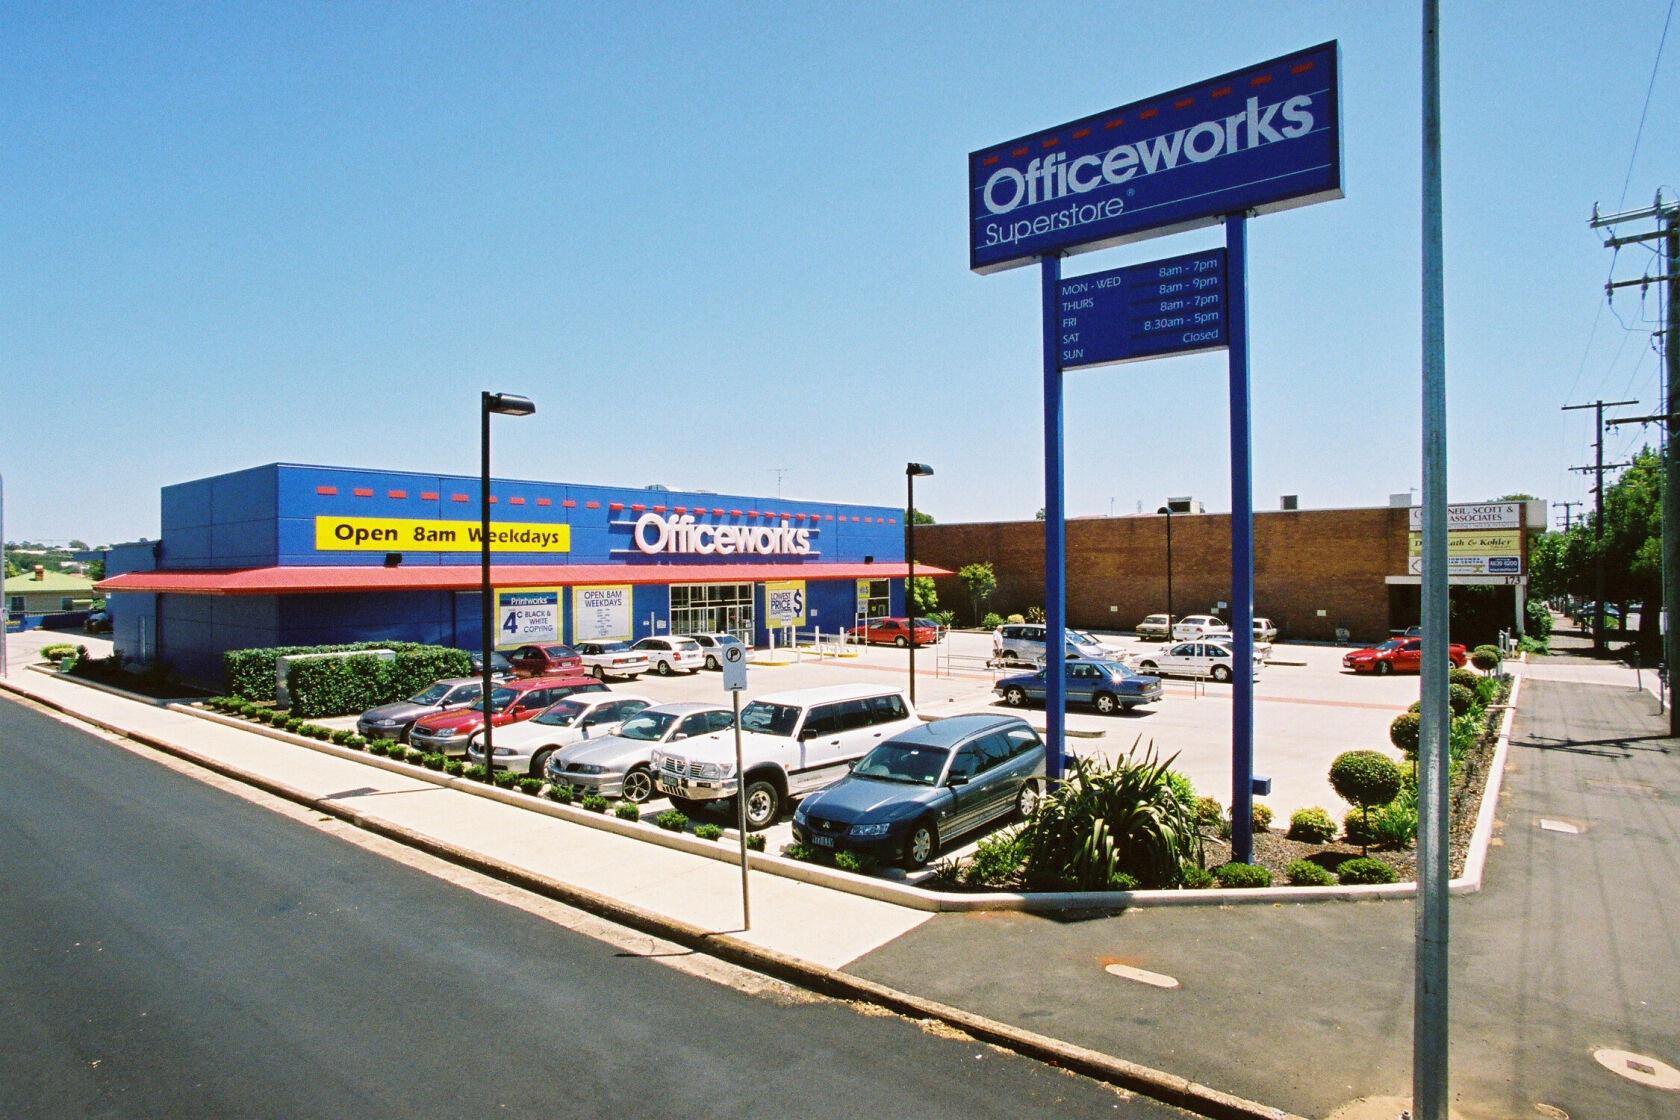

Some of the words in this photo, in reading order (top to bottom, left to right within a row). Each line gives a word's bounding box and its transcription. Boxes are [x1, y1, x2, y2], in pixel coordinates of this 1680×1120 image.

[983, 94, 1314, 214] Officeworks
[985, 196, 1124, 246] Superstore
[1062, 283, 1088, 296] MON
[1096, 276, 1121, 289] WED
[1159, 267, 1182, 278] 8am
[1193, 259, 1218, 272] 7pm
[1062, 298, 1094, 312] THURS
[1159, 284, 1182, 294] 8am
[1192, 276, 1218, 290] 9pm
[1062, 317, 1077, 328] FRI
[1160, 301, 1184, 312] 8am
[1194, 294, 1218, 308] 7pm
[1063, 332, 1080, 344] SAT
[1144, 317, 1184, 331] 8.30am
[1194, 311, 1219, 325] 5pm
[1063, 349, 1084, 360] SUN
[1182, 329, 1219, 343] Closed
[1472, 506, 1503, 515] SCOTT
[1506, 505, 1514, 513] &
[1448, 514, 1502, 522] ASSOCIATES
[334, 524, 399, 545] Open
[414, 526, 456, 543] 8am
[468, 528, 559, 548] Weekdays
[634, 512, 812, 556] Officeworks
[1480, 538, 1512, 546] Kohler
[1504, 576, 1521, 584] 173
[584, 591, 604, 599] OPEN
[606, 590, 622, 598] 8AM
[770, 592, 791, 600] LOWEST
[511, 597, 548, 605] Printworks
[584, 598, 622, 607] WEEKDAYS
[770, 599, 791, 609] PRICE
[524, 610, 545, 618] BLACK
[523, 625, 553, 633] COPYING
